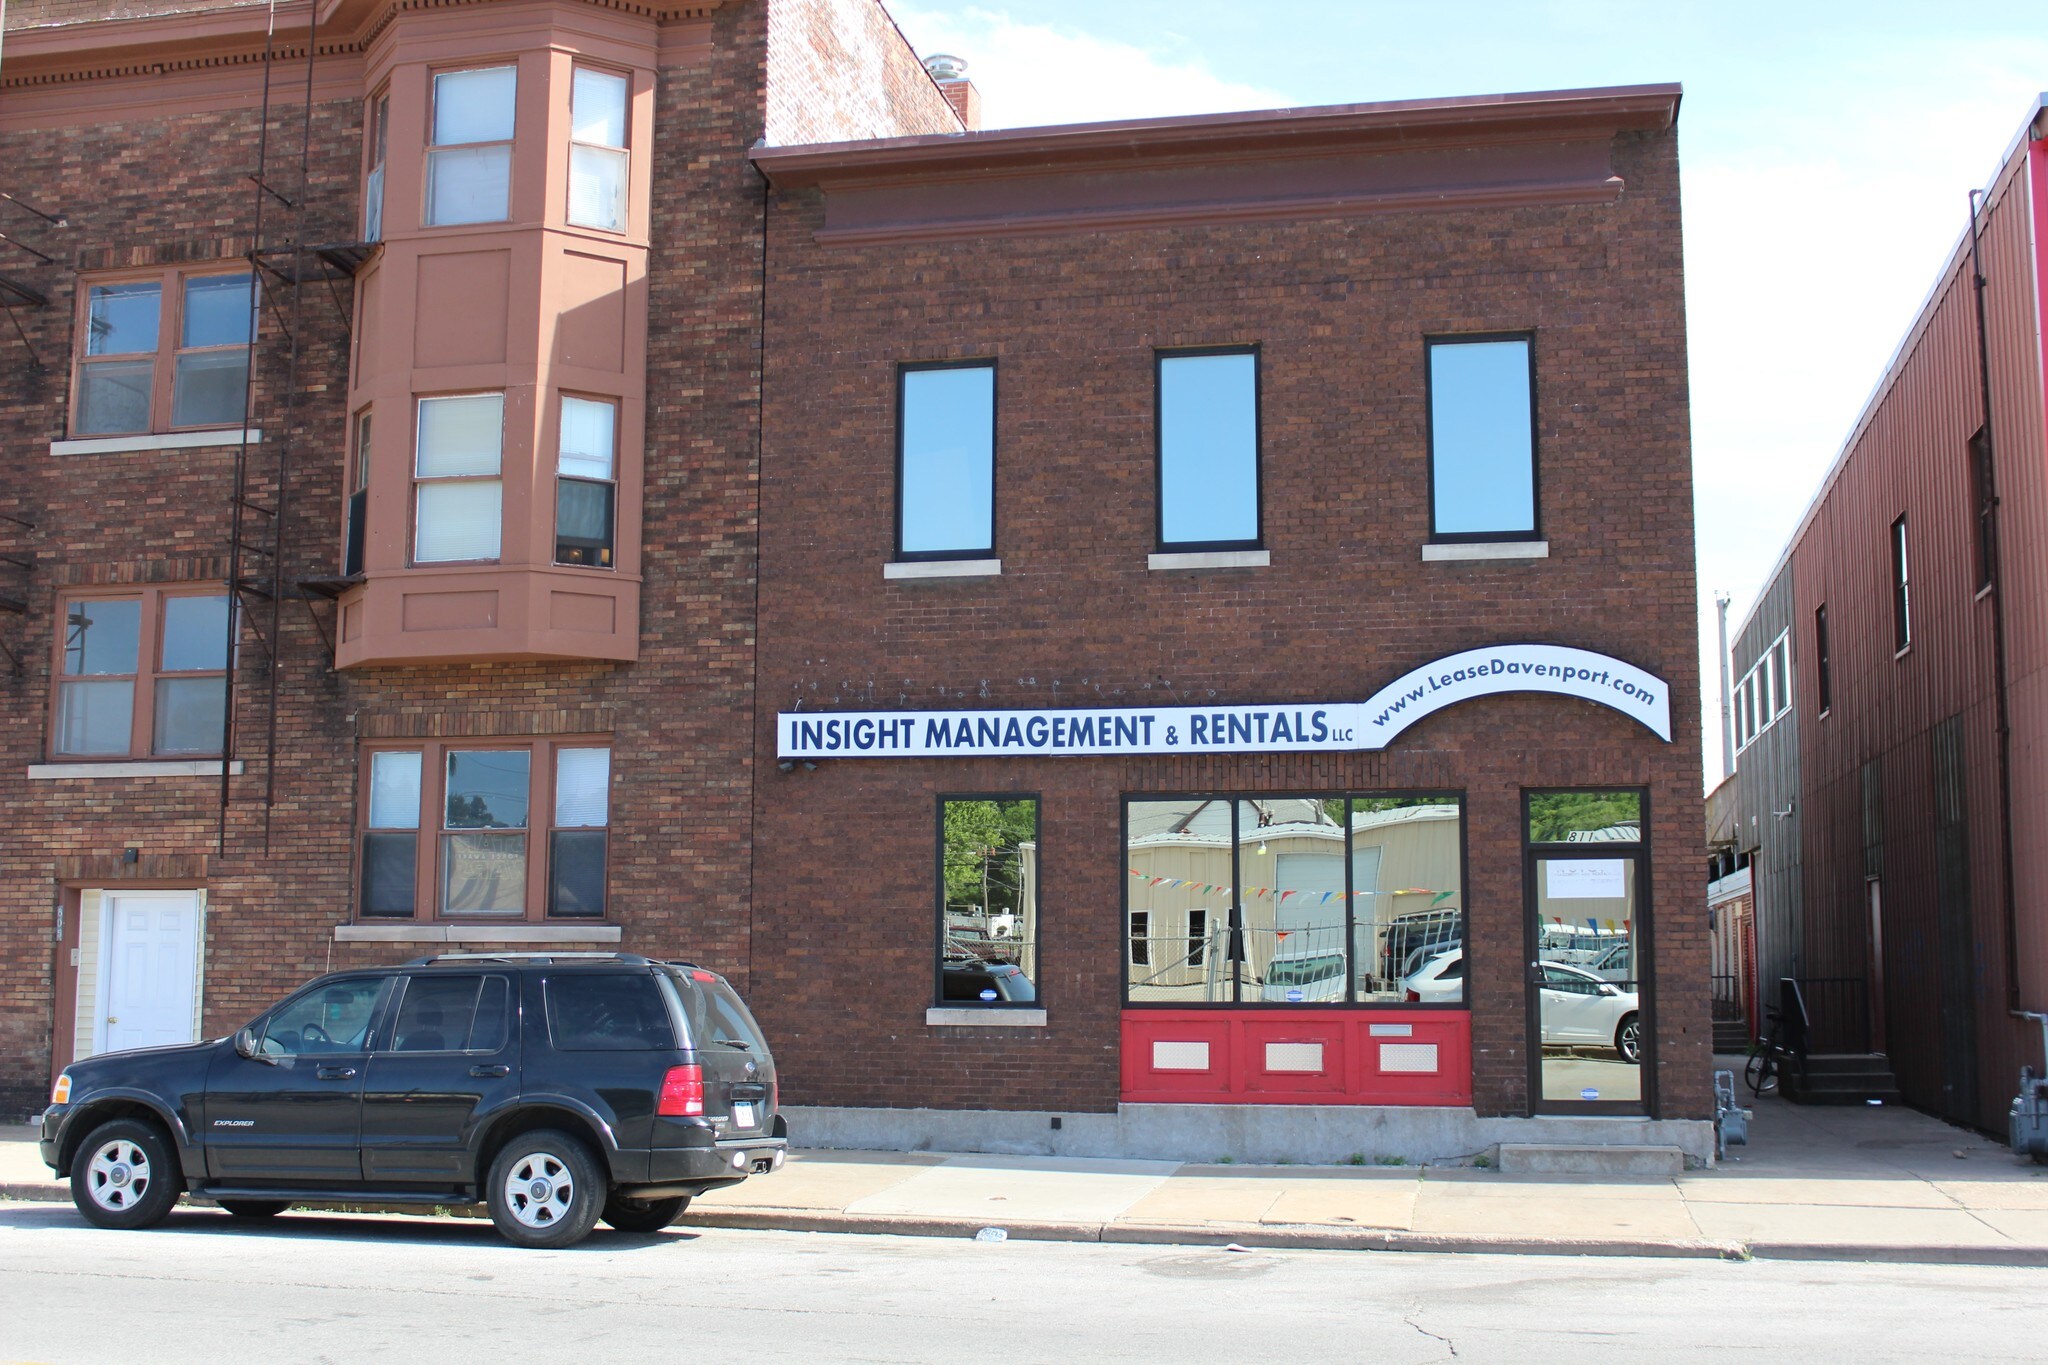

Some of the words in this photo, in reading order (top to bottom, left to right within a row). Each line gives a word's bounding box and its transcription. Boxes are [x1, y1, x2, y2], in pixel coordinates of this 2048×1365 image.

[1372, 658, 1655, 727] www.LeaseDavenport.com
[791, 719, 915, 750] INSIGHT
[925, 715, 1155, 748] MANAGEMENT
[1165, 725, 1179, 745] &
[1190, 710, 1328, 745] RENTALS
[1332, 728, 1353, 742] LLC
[1569, 832, 1593, 842] 811
